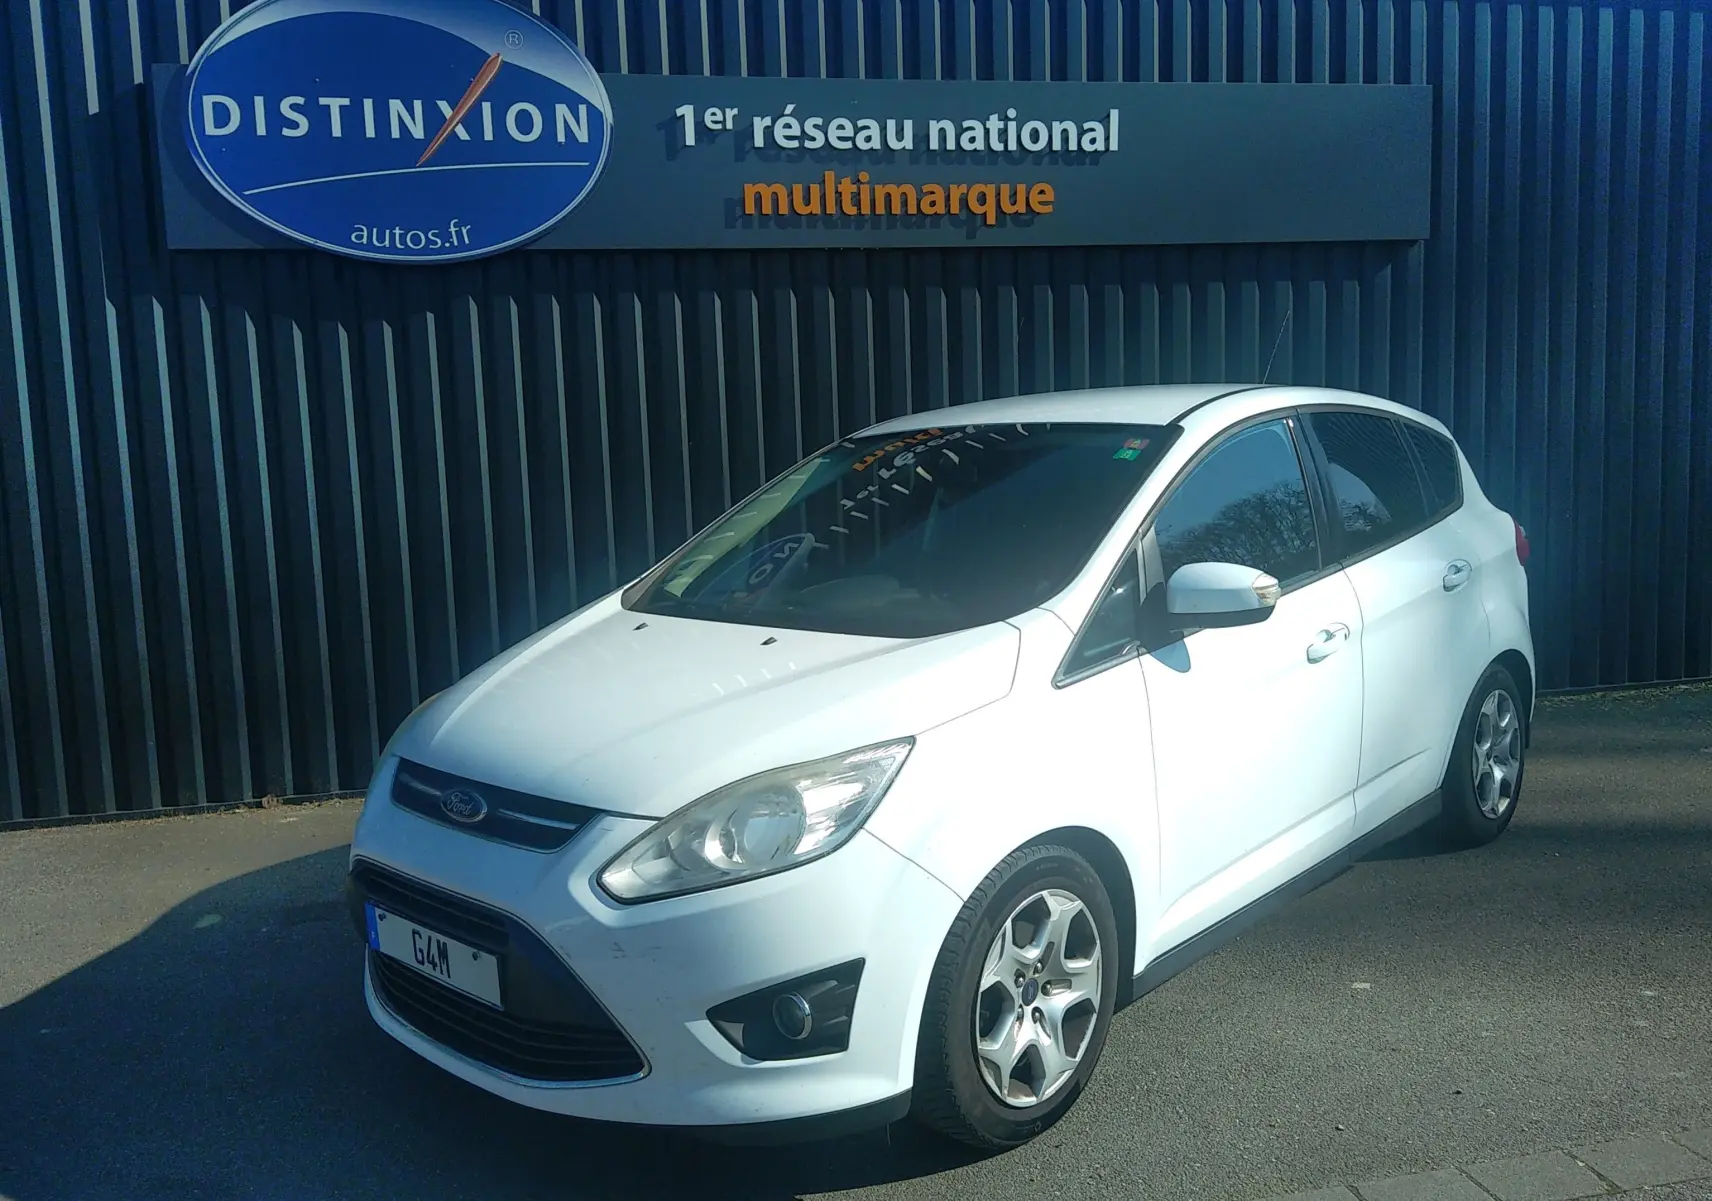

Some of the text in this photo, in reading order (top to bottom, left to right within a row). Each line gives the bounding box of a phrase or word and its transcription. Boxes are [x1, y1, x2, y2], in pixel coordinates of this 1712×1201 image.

[201, 93, 591, 145] DISTINXION
[675, 103, 1120, 153] 1er réseau national
[743, 170, 1056, 225] multimarque
[349, 218, 474, 250] autos.fr
[446, 791, 475, 816] Ford
[411, 928, 451, 979] G4M
